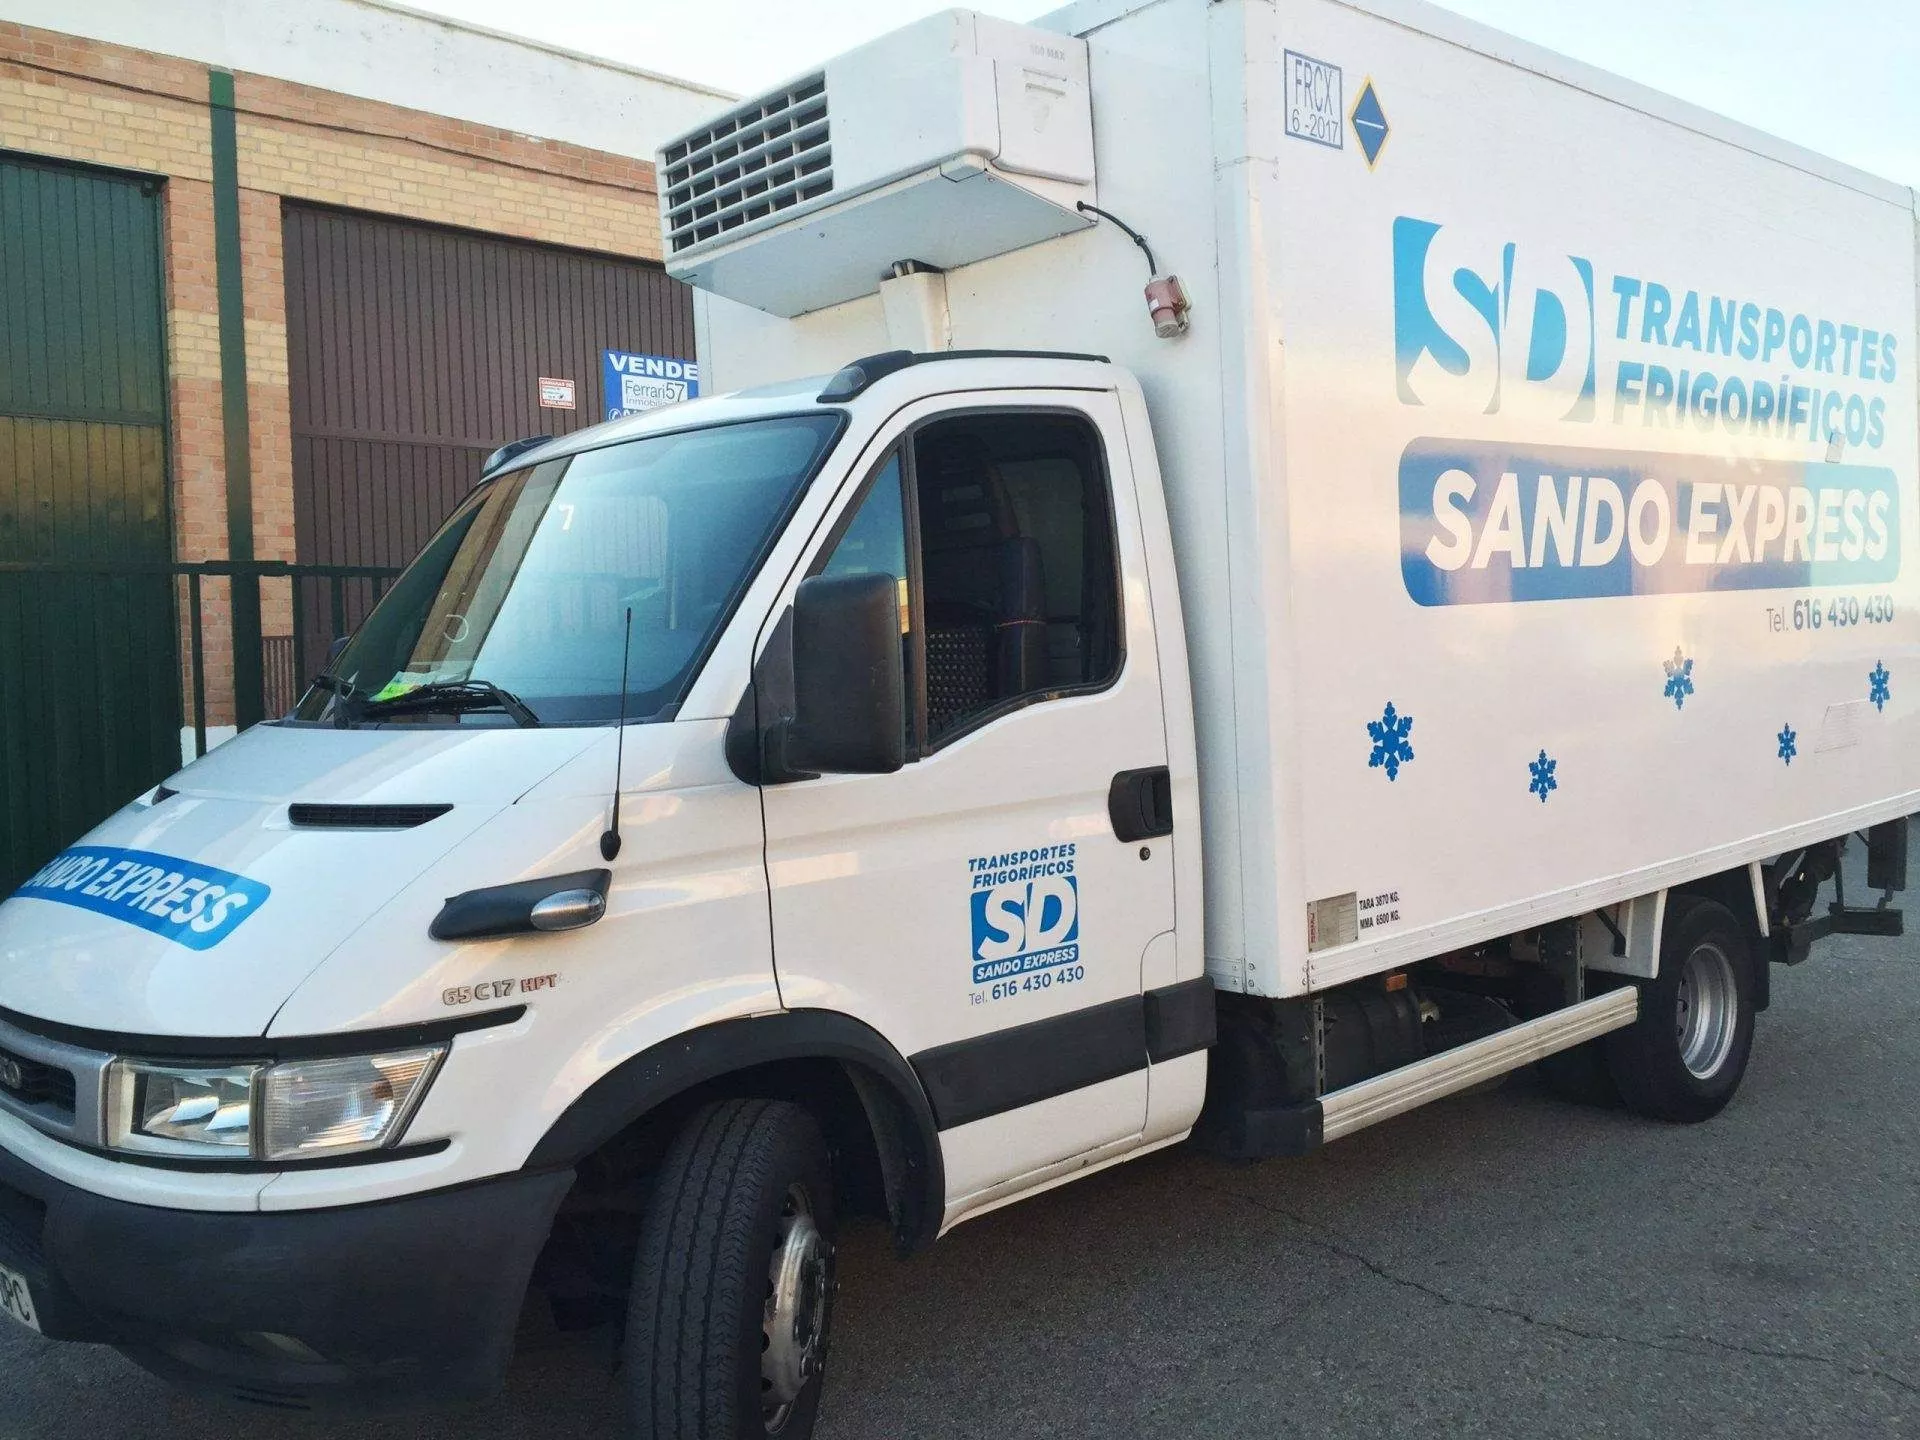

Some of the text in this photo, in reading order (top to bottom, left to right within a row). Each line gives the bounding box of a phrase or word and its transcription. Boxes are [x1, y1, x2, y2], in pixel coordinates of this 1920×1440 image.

[1295, 59, 1333, 116] FRCX
[1405, 222, 1593, 423] SD
[1612, 274, 1898, 384] TRANSPORTES
[609, 353, 698, 381] VENDE
[1612, 361, 1886, 449] FRIGORÍFICOS
[1424, 469, 1891, 571] SANDO EXPRESS
[1766, 594, 1894, 632] Tel. 616 430 430
[968, 843, 1076, 872] TRANSPORTES
[973, 860, 1074, 888] FRIGORÍFICOS
[21, 856, 249, 933] ANDO EXPRESS
[1359, 897, 1375, 911] TARA
[977, 877, 1077, 960] SD
[521, 974, 557, 993] HPT
[969, 965, 1084, 1006] Tel. 616 430 430
[976, 947, 1076, 981] SANDO EXPRESS
[0, 1270, 30, 1321] PC
